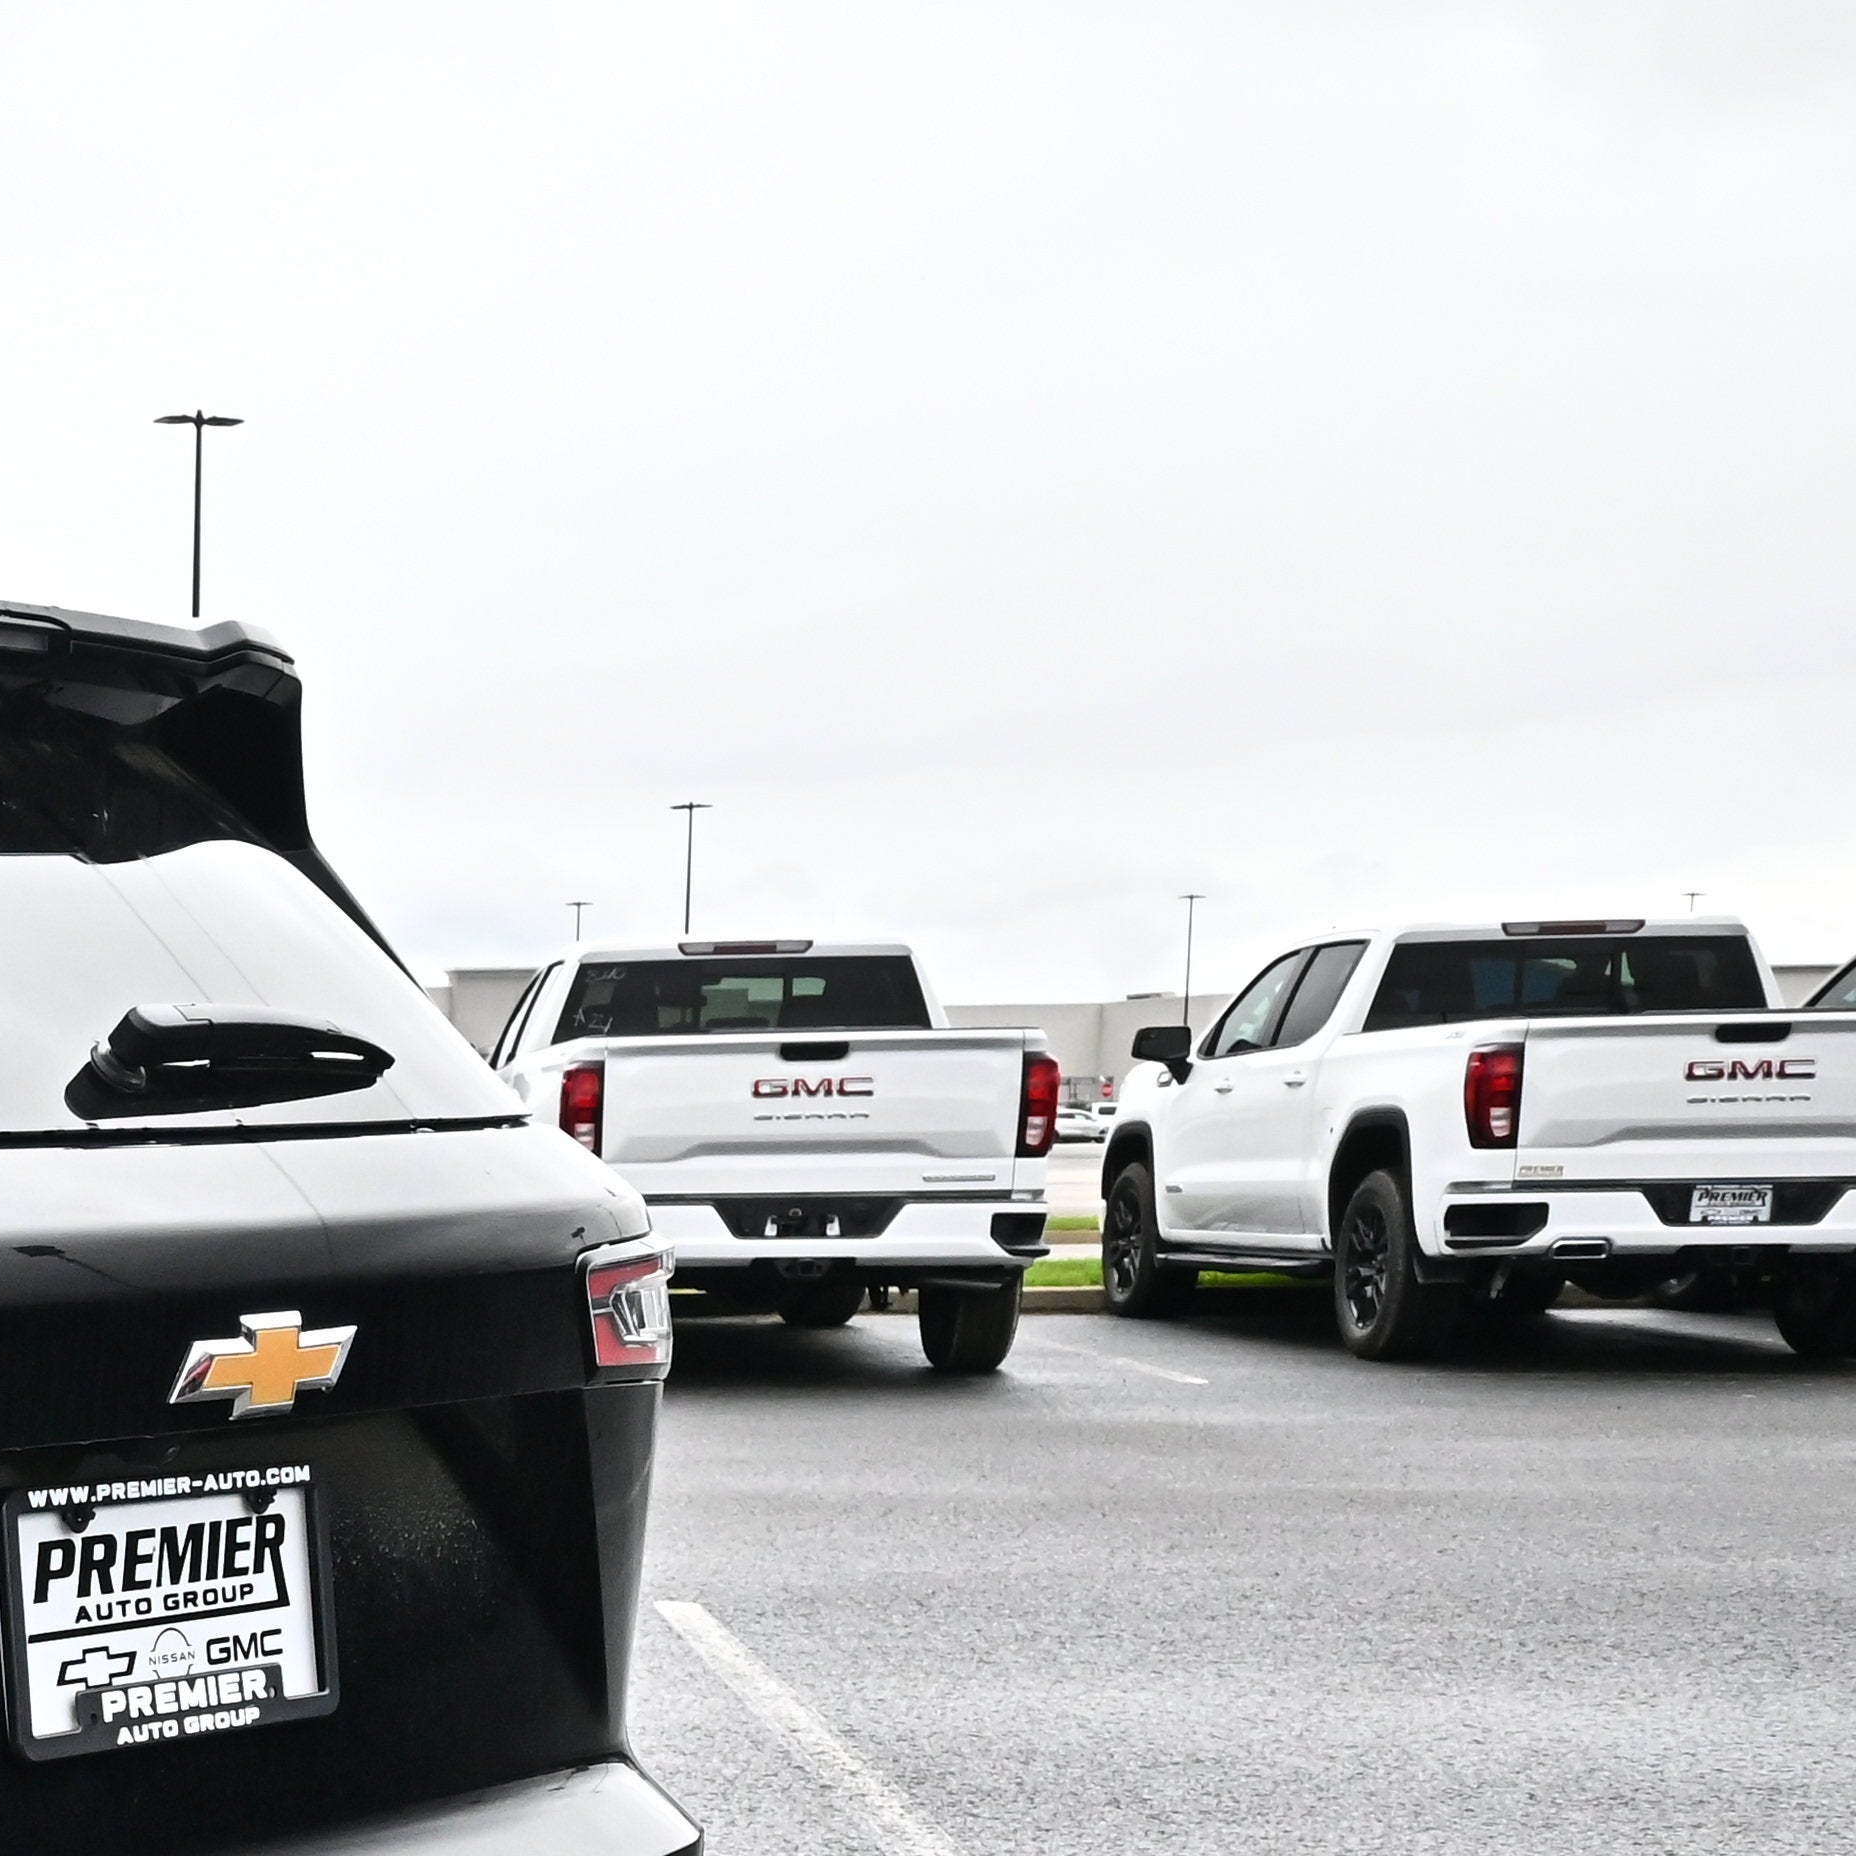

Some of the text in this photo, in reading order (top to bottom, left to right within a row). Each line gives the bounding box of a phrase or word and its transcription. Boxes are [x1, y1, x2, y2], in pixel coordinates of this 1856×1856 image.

[752, 1076, 874, 1098] GMC
[1685, 1058, 1816, 1081] GMC
[27, 1465, 310, 1509] WWW.PREMIER-AUTO.COM
[33, 1512, 291, 1606] PREMIER
[74, 1582, 255, 1624] AUTO GROUP
[148, 1650, 196, 1666] NISSAN
[206, 1628, 284, 1666] GMC
[101, 1668, 268, 1723] PREMIER
[116, 1706, 261, 1746] AUTO GROUP
